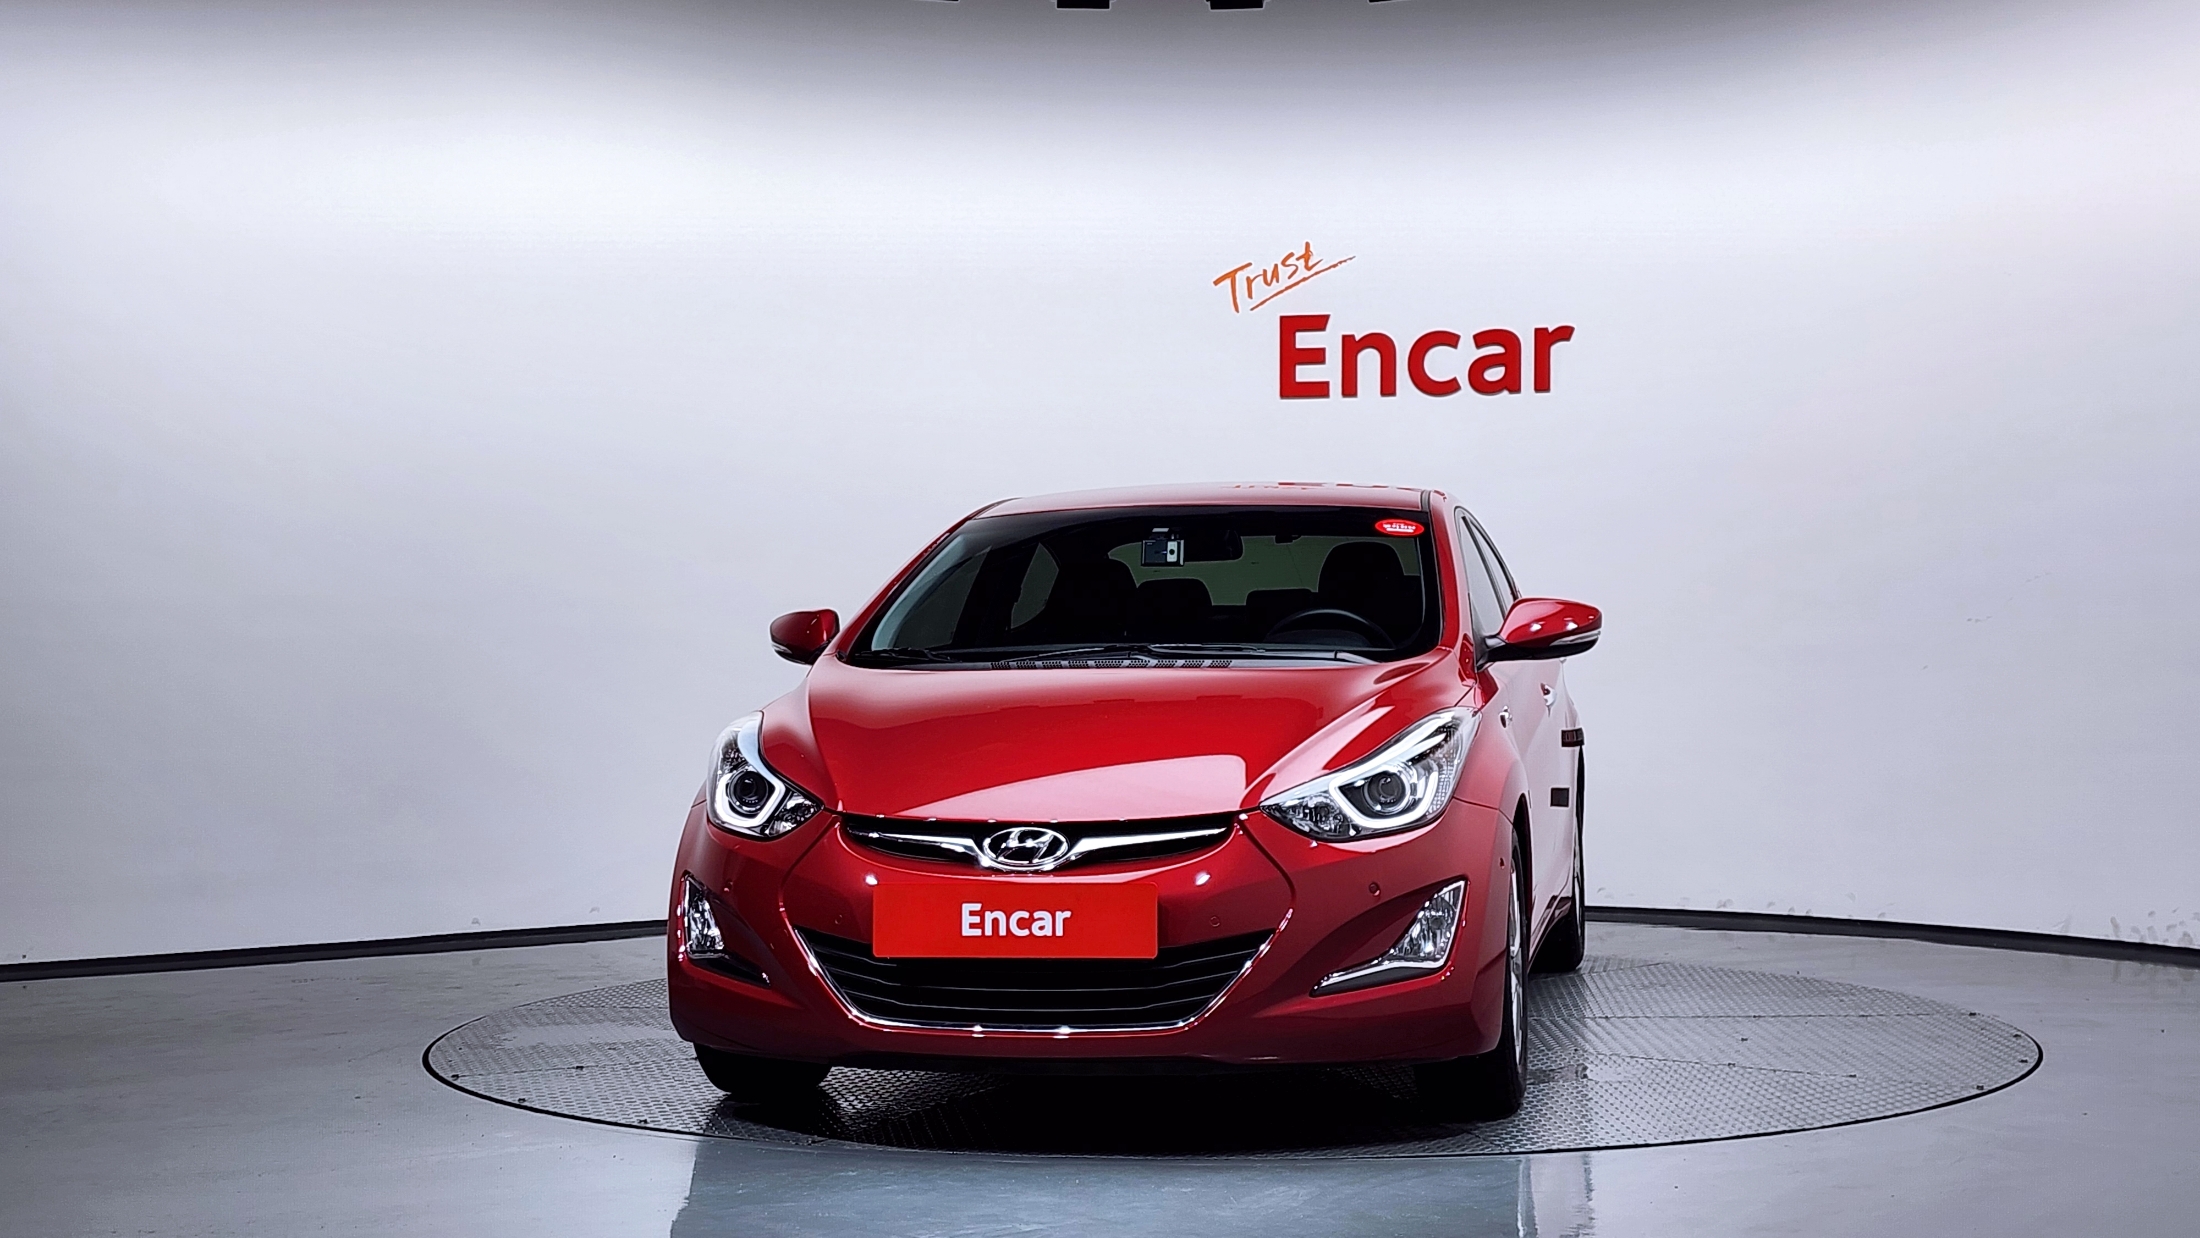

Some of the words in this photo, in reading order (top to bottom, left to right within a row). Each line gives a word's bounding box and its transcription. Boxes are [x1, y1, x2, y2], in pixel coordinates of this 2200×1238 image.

[1213, 241, 1324, 313] Trust
[1279, 314, 1575, 399] Encar
[961, 902, 1072, 937] Encar
